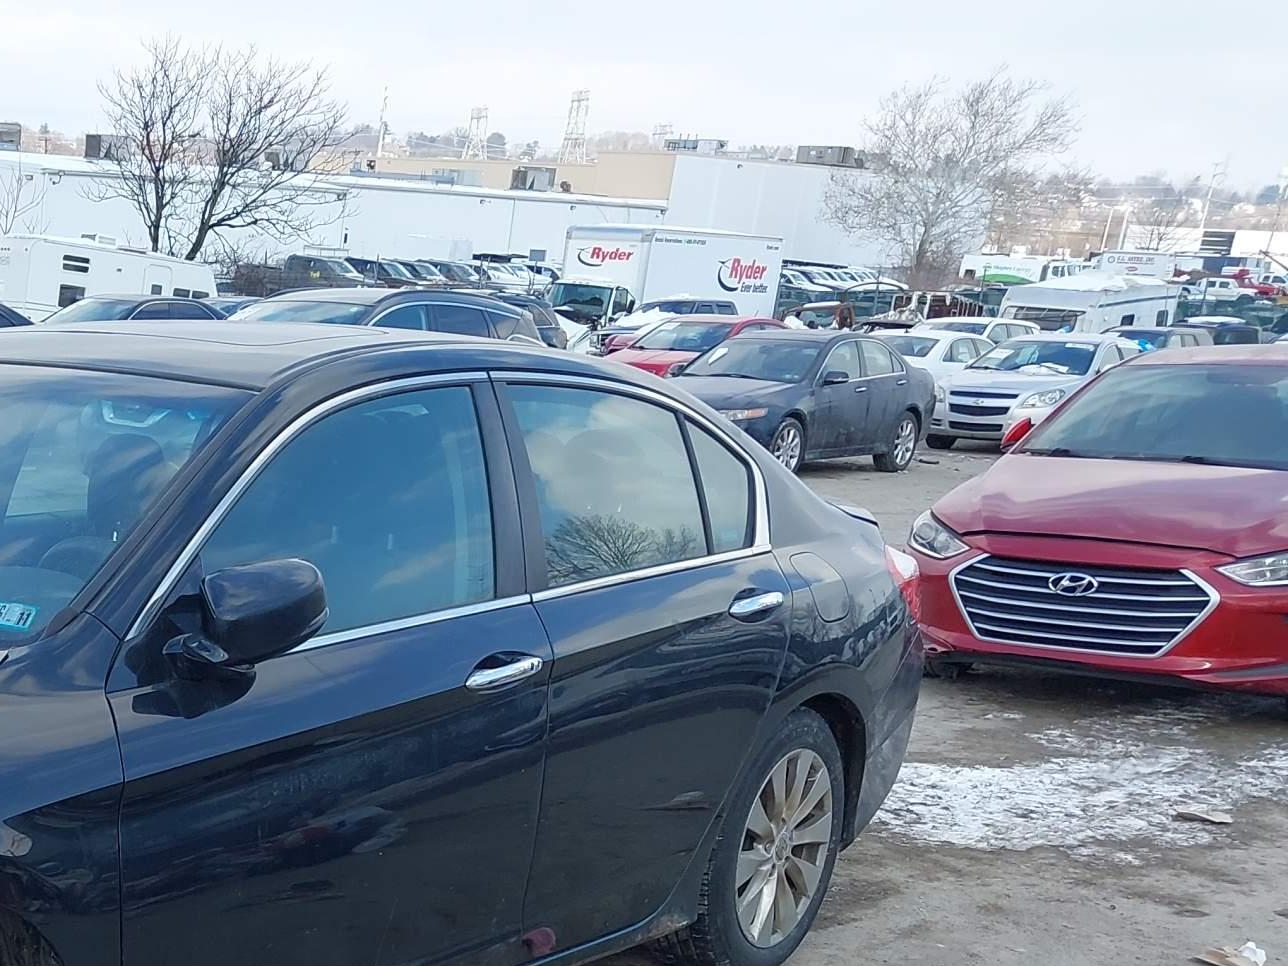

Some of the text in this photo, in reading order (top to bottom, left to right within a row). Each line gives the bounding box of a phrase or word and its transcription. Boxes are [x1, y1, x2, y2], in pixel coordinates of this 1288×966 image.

[590, 246, 634, 263] Ryder
[728, 257, 768, 284] Ryder
[16, 610, 32, 627] 11
